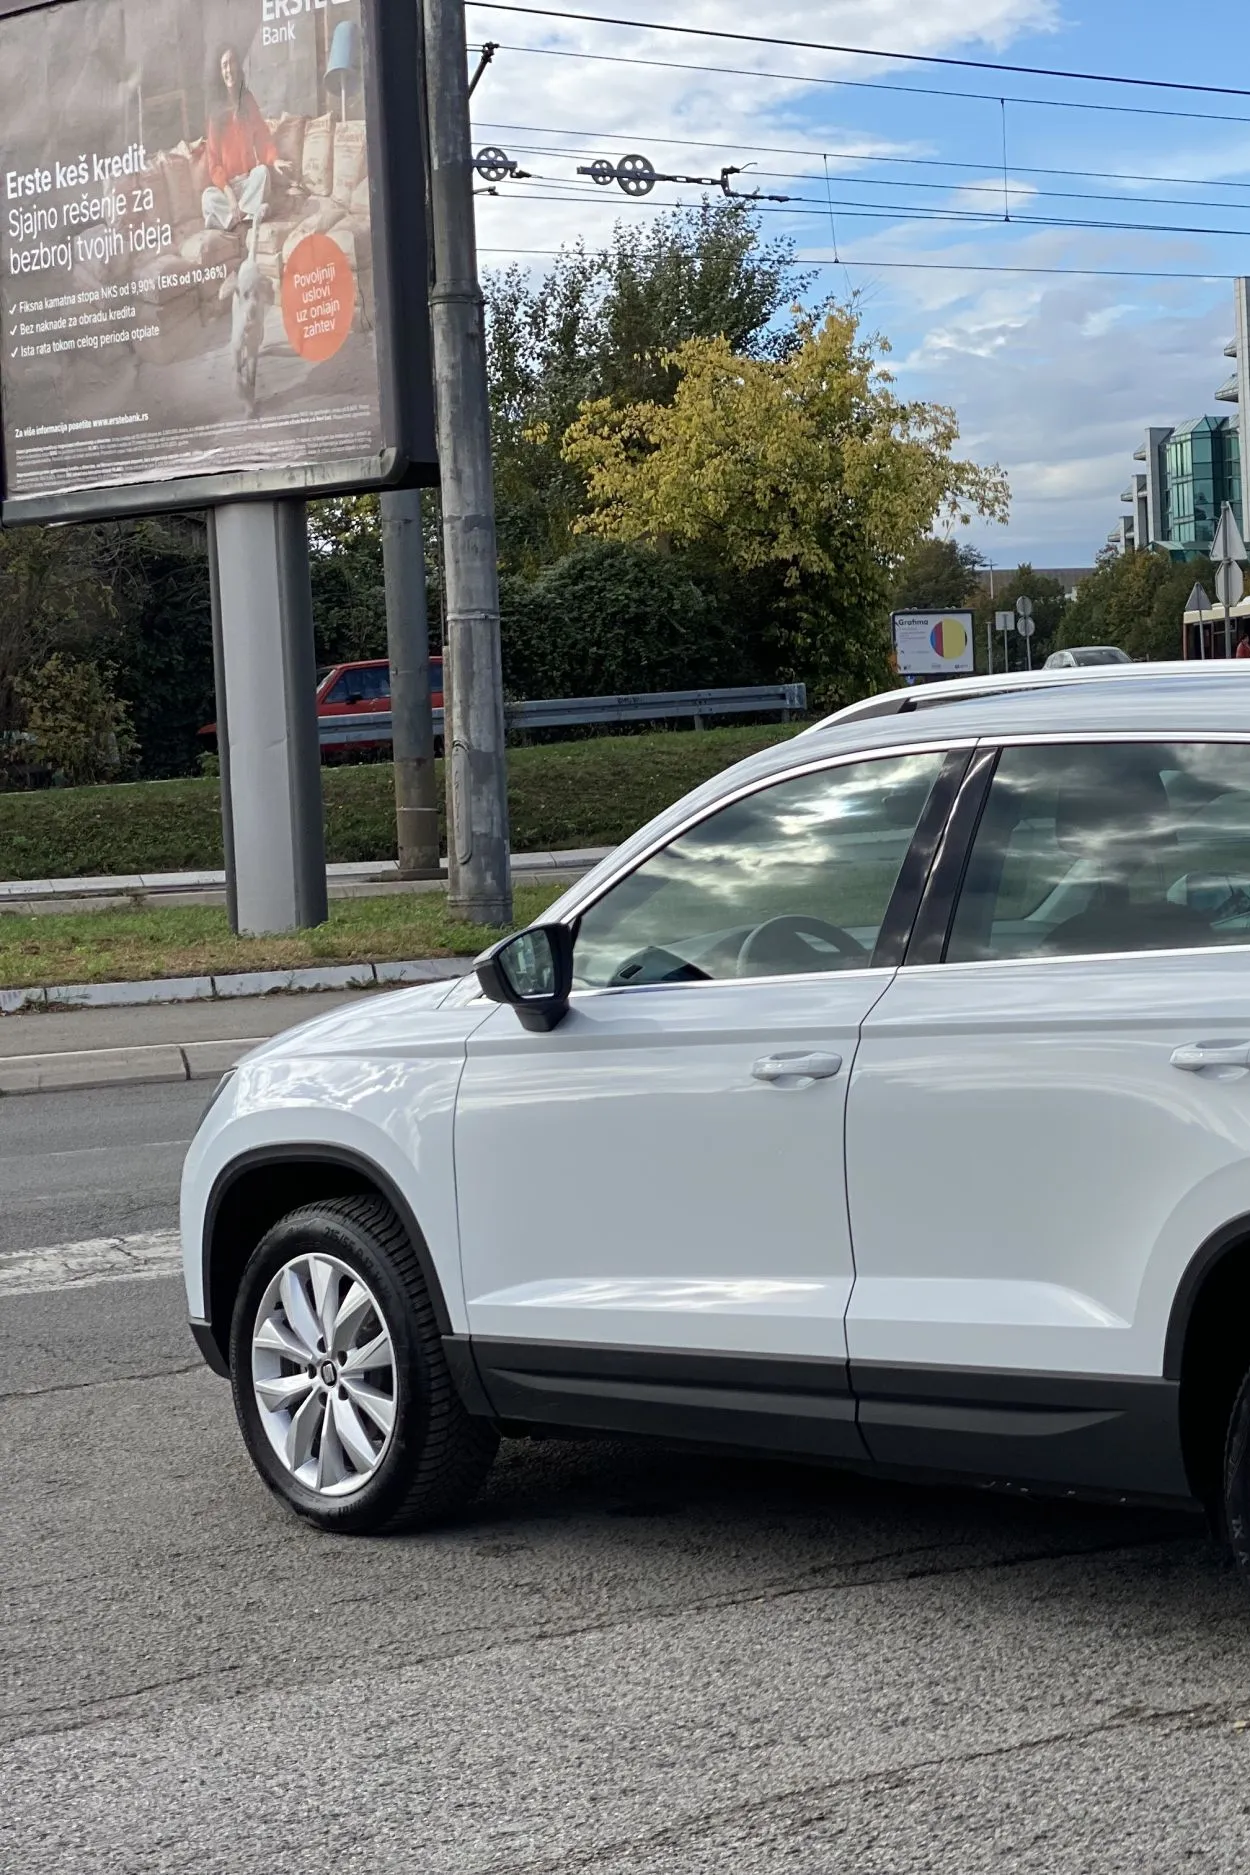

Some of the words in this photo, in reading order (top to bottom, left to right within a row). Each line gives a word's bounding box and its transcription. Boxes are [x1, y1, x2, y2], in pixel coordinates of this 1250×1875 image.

[263, 20, 296, 46] Bank
[6, 168, 52, 200] Erste
[55, 154, 89, 189] keš
[93, 143, 147, 182] kredit
[8, 204, 58, 242] Sjajno
[63, 188, 127, 226] rešenje
[132, 187, 154, 213] za
[10, 236, 72, 275] bezbroj
[76, 228, 124, 264] tvojih
[129, 217, 172, 254] ideja
[19, 301, 43, 313] Fiksna
[44, 294, 76, 309] kamatna
[77, 290, 100, 304] stopa
[101, 285, 117, 299] NKS
[120, 283, 129, 296] od
[158, 273, 178, 290] (EKS
[179, 272, 191, 285] od
[192, 263, 227, 284] 10,36%)
[293, 262, 336, 289] Povoljniji
[302, 281, 331, 304] uslovi
[20, 323, 34, 335] Bez
[36, 318, 67, 332] naknade
[68, 316, 77, 327] za
[79, 310, 107, 324] obradu
[109, 305, 136, 320] kredita
[296, 309, 308, 323] uz
[310, 298, 341, 319] onlajn
[20, 345, 35, 357] Ista
[36, 342, 51, 355] rata
[52, 339, 76, 353] tokom
[77, 335, 99, 349] celog
[100, 330, 130, 347] perioda
[131, 325, 160, 341] otplate
[303, 318, 336, 338] zahtev
